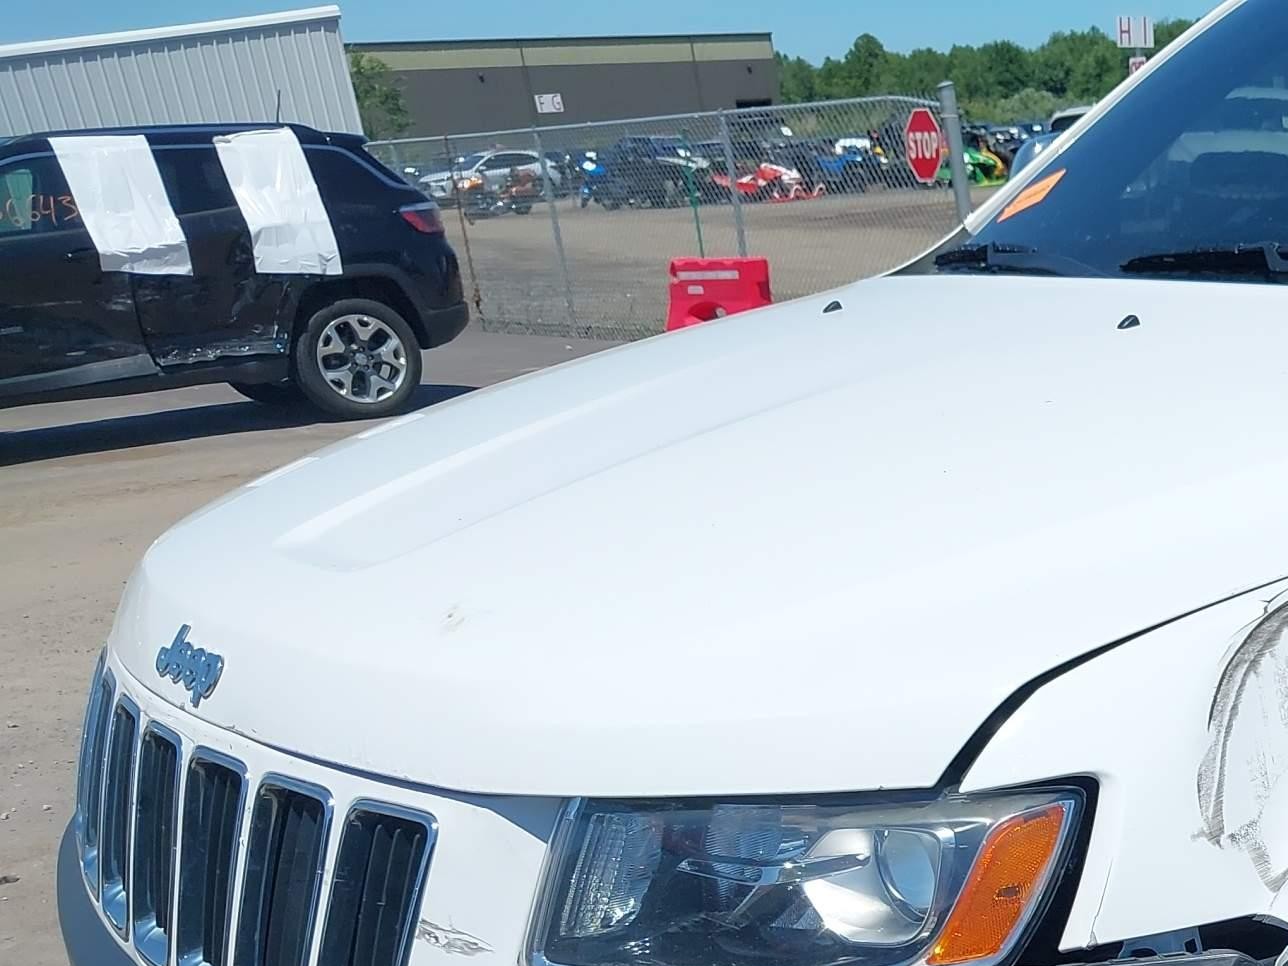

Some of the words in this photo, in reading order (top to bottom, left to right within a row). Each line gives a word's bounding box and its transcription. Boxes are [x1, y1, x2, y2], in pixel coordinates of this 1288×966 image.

[1119, 17, 1131, 45] H
[538, 95, 545, 112] F
[551, 94, 562, 111] G
[908, 131, 938, 160] STOP
[156, 624, 225, 708] Jeep
